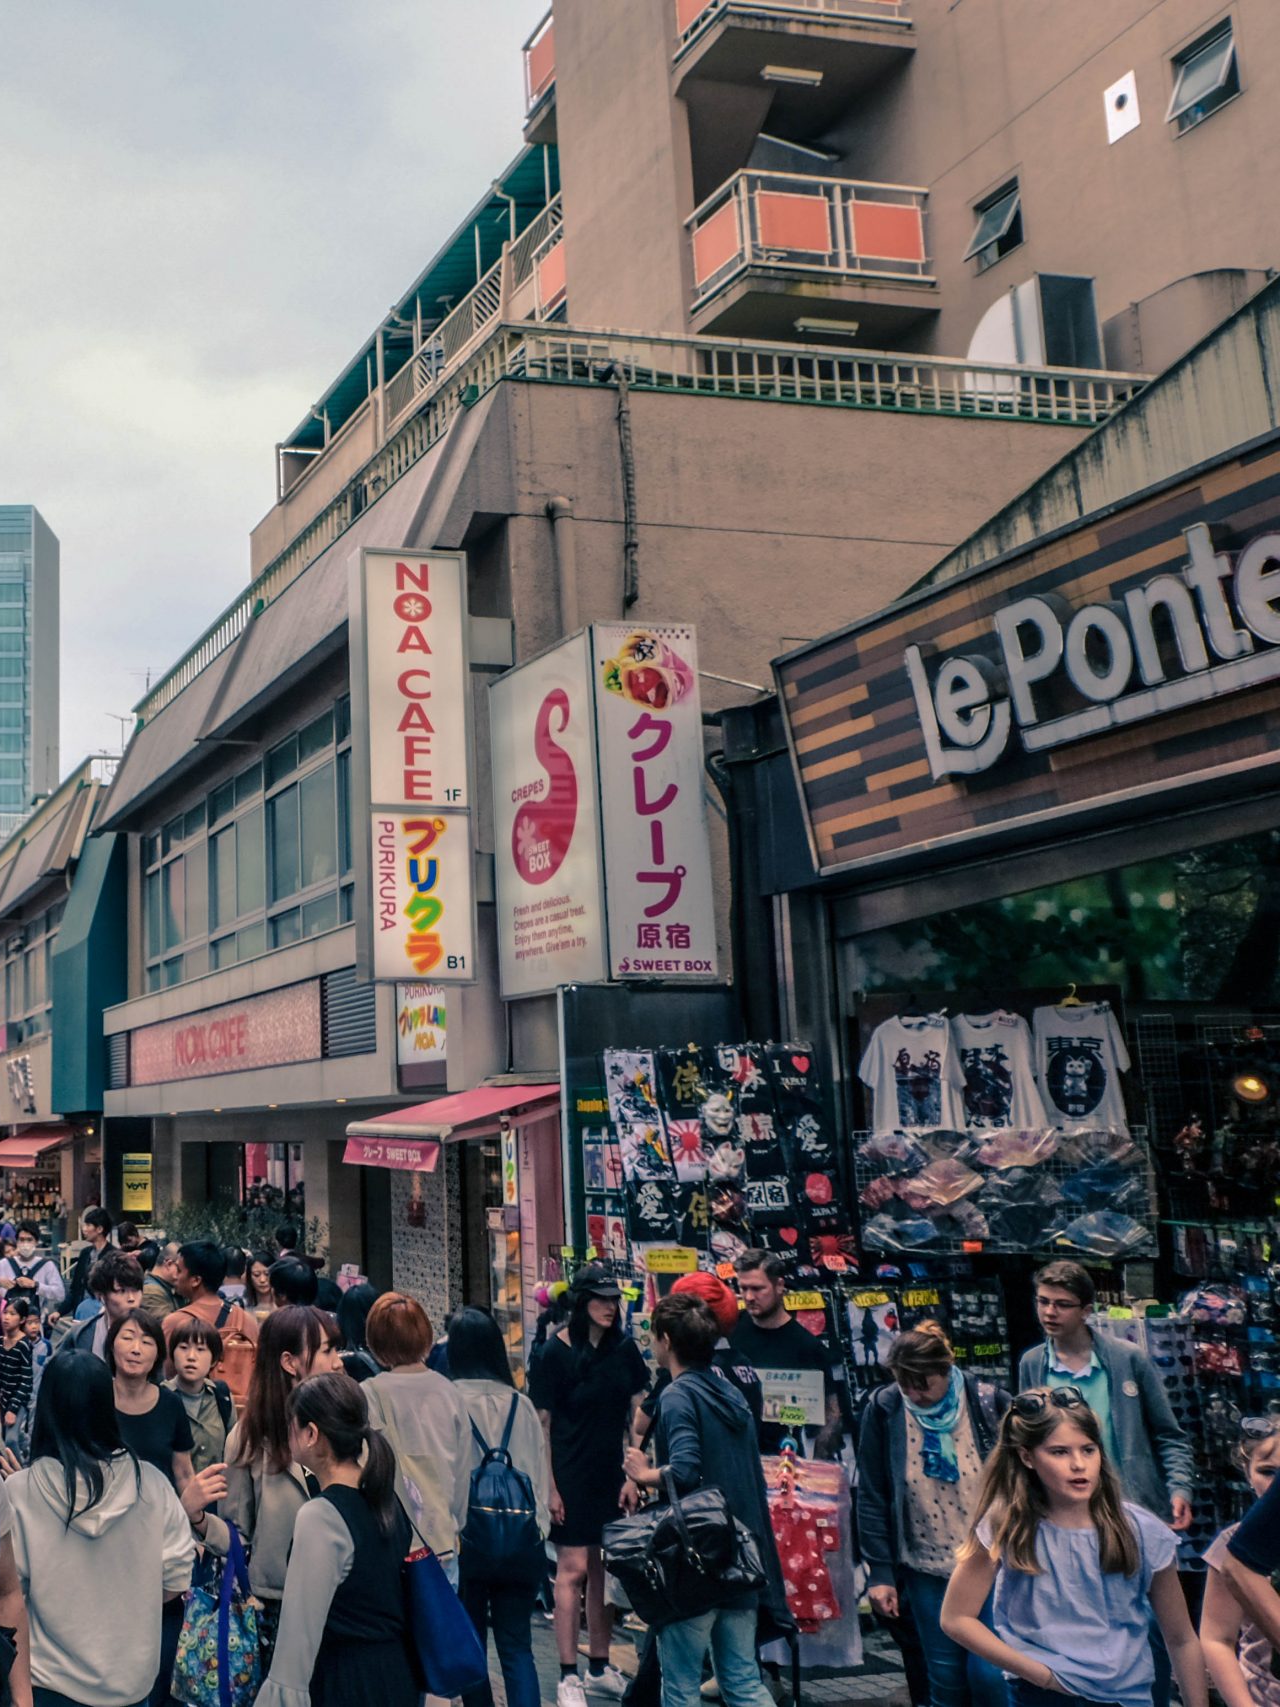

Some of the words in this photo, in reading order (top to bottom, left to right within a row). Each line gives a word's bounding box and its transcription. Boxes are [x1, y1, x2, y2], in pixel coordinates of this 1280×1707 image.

[393, 562, 432, 655] NOA
[396, 669, 435, 800] CAFE
[444, 788, 462, 802] 1F
[511, 779, 544, 803] CREPES
[627, 712, 687, 918] クレープ
[528, 839, 550, 856] SWEET
[529, 853, 552, 873] BOX
[378, 821, 397, 932] PURIKURA
[402, 817, 447, 975] プリクラ
[637, 923, 691, 949] 原宿
[447, 955, 466, 969] B1
[633, 960, 681, 972] SWEET
[684, 960, 712, 972] BOX
[208, 1014, 249, 1060] CAFE
[386, 1148, 407, 1161] SWEET
[812, 1207, 838, 1216] JAPAN
